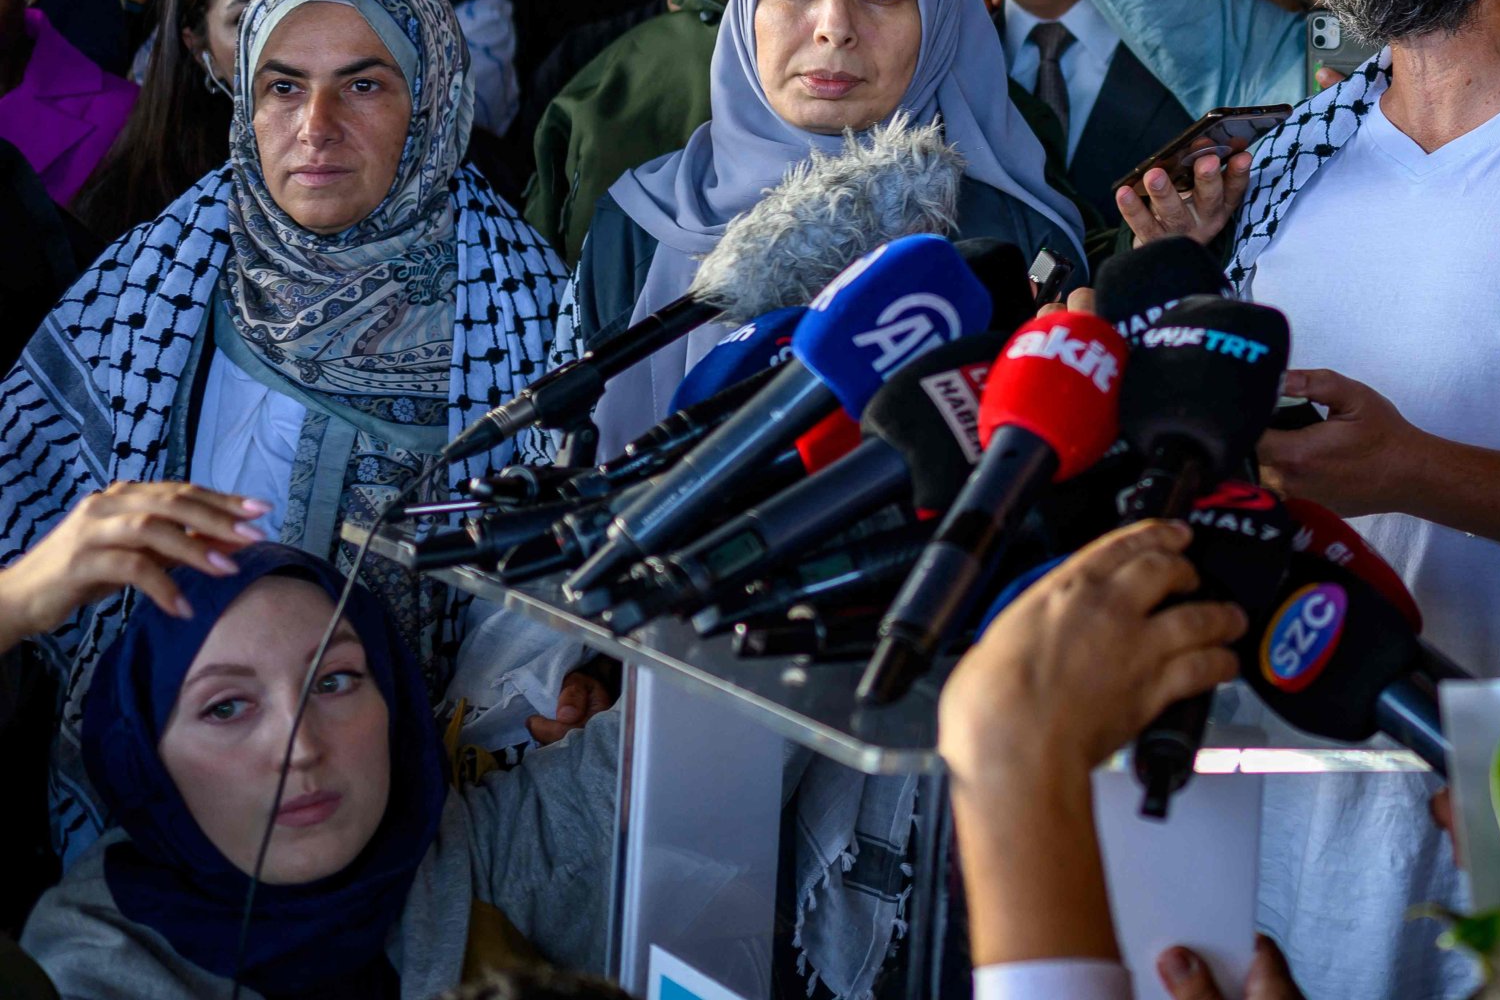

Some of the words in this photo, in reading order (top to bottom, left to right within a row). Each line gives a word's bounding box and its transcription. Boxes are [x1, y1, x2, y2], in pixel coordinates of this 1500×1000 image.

[1006, 325, 1118, 393] akit
[1188, 508, 1280, 541] NAL7
[1273, 593, 1336, 676] SZC
